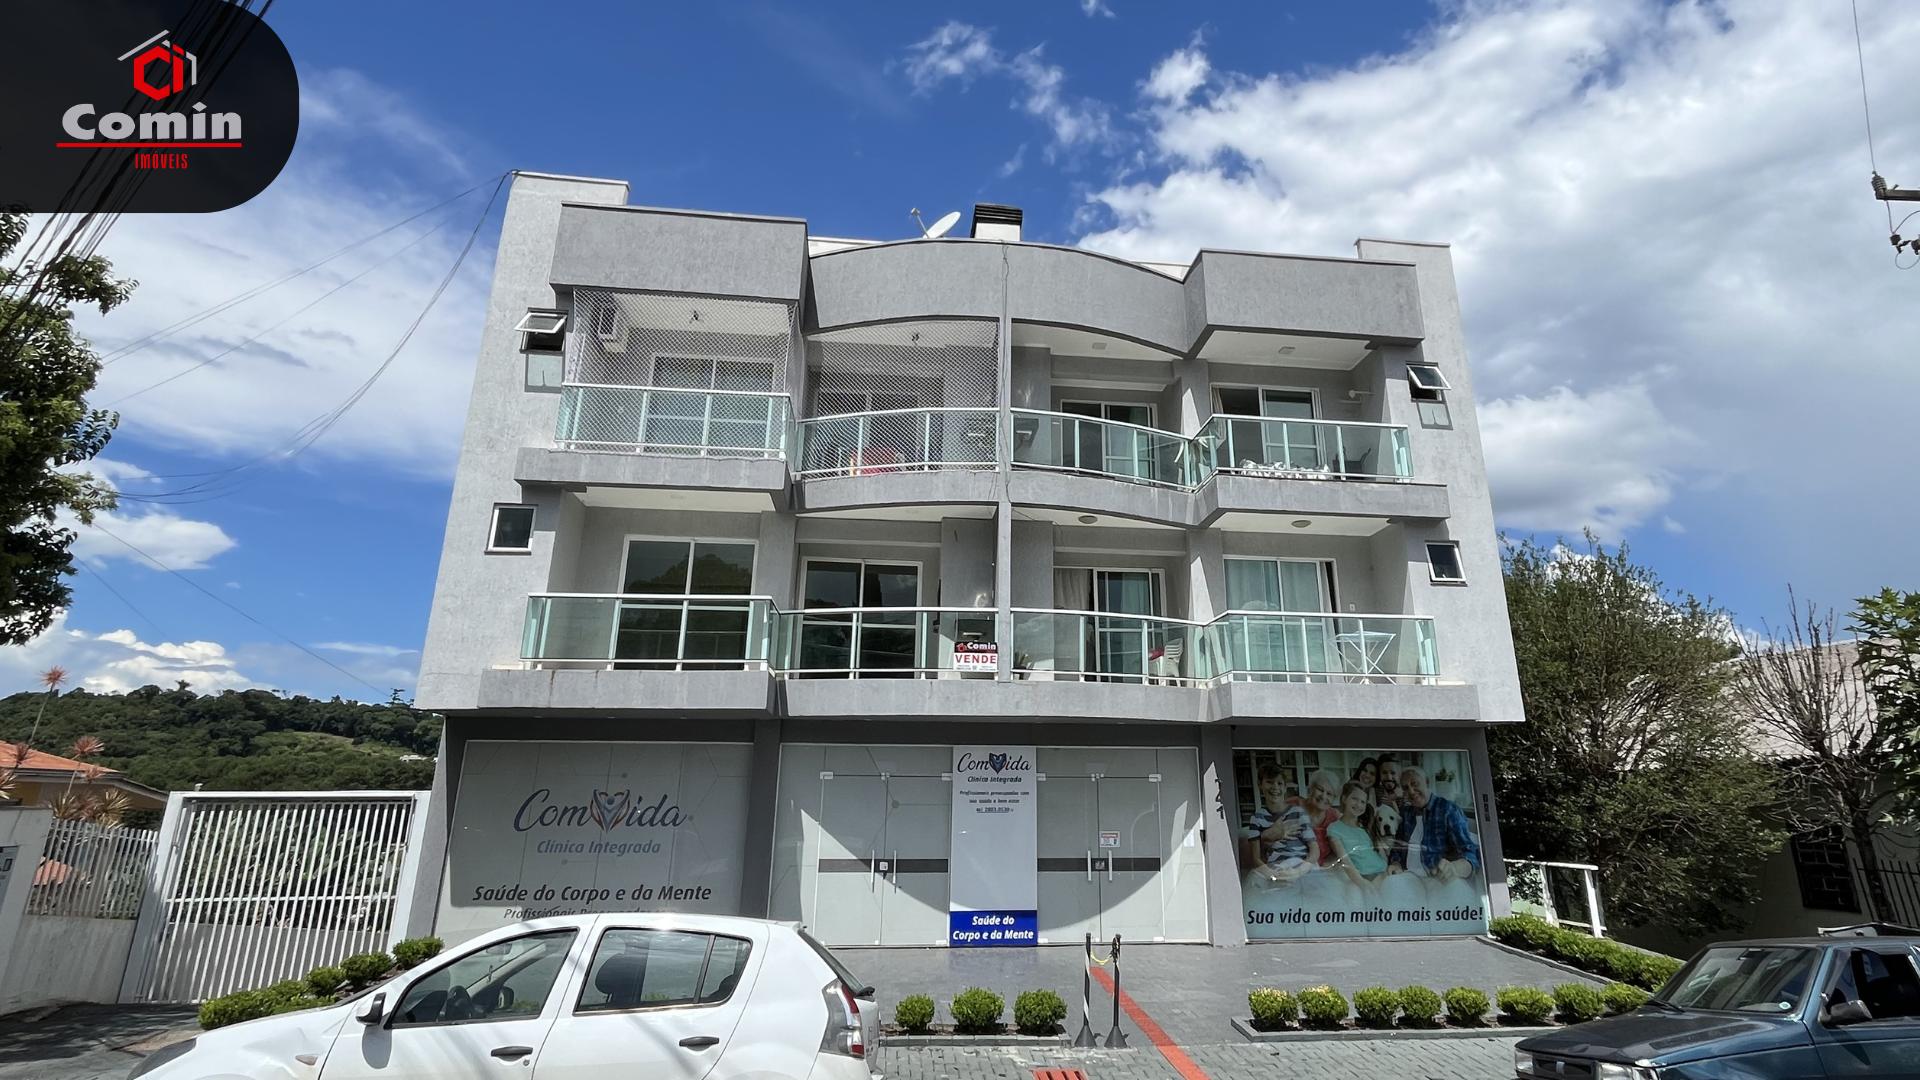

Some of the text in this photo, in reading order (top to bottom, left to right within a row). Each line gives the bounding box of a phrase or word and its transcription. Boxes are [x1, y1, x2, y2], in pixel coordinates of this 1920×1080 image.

[967, 642, 996, 650] Comin
[955, 655, 996, 663] VENDE
[536, 839, 662, 857] Clínica Integrada
[472, 883, 713, 905] Saúde do Corpo e da Mente
[972, 915, 1015, 925] Saúde do
[1247, 905, 1484, 925] Sua vida com muito mais saúde!
[953, 930, 1034, 942] Corpo e da Mente
